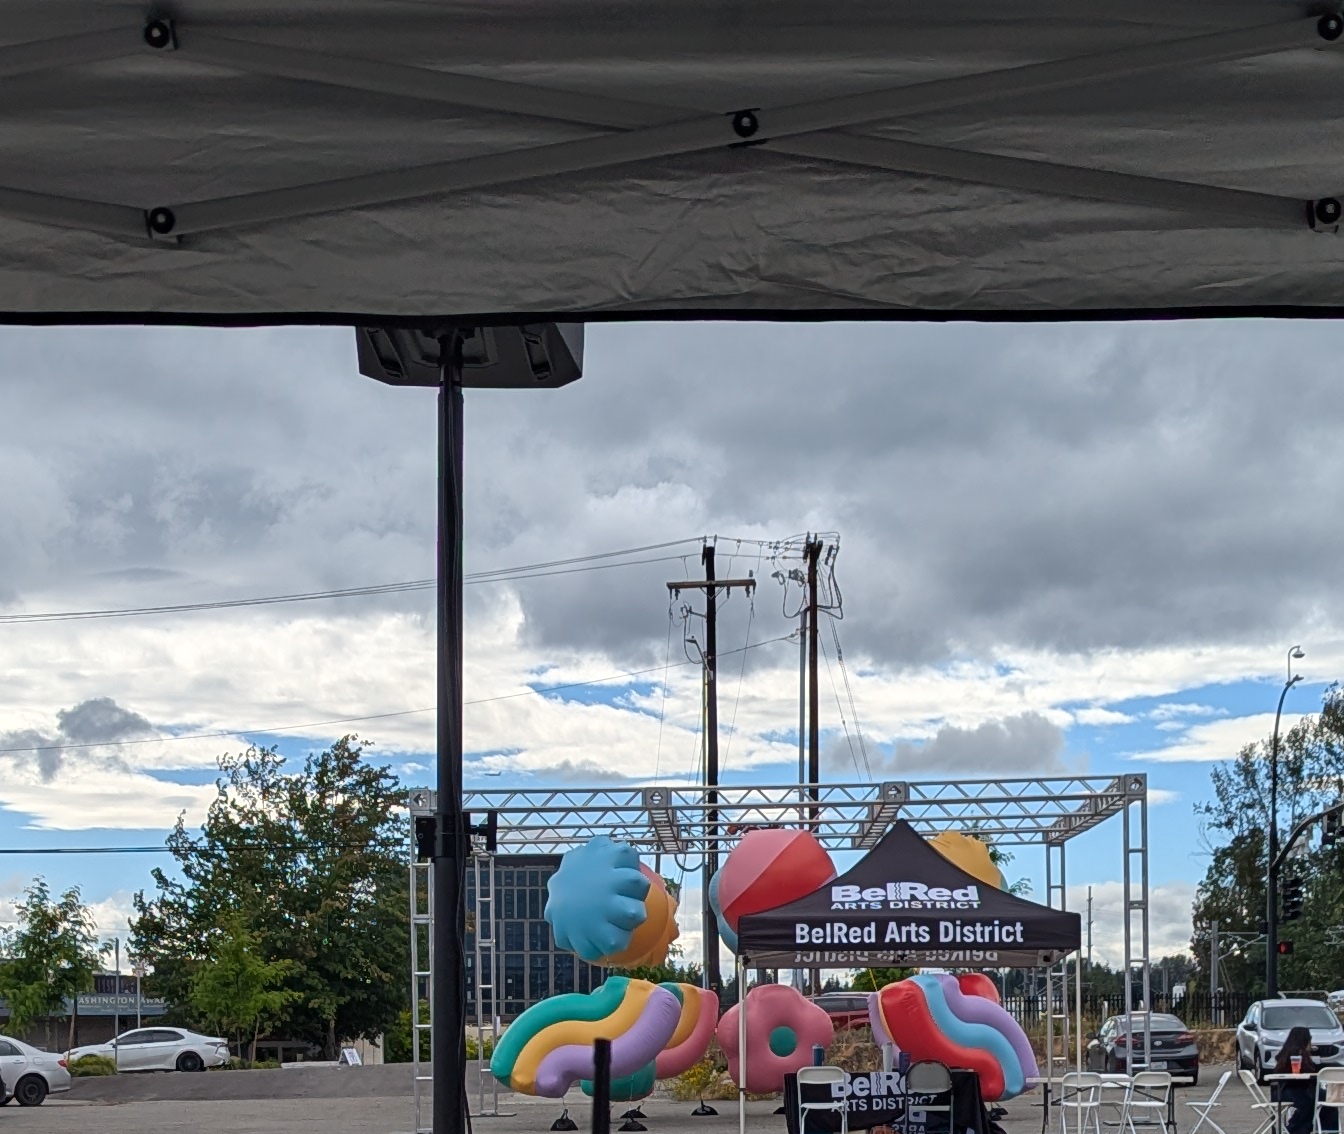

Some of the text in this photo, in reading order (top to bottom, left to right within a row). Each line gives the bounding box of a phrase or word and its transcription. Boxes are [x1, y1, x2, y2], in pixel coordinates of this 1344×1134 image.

[831, 882, 980, 902] BelRed
[830, 901, 982, 910] ARTS DISTRICT
[795, 920, 1024, 944] BelRed Arts District
[71, 996, 135, 1005] ASHINGTON
[831, 1072, 914, 1098] BelR
